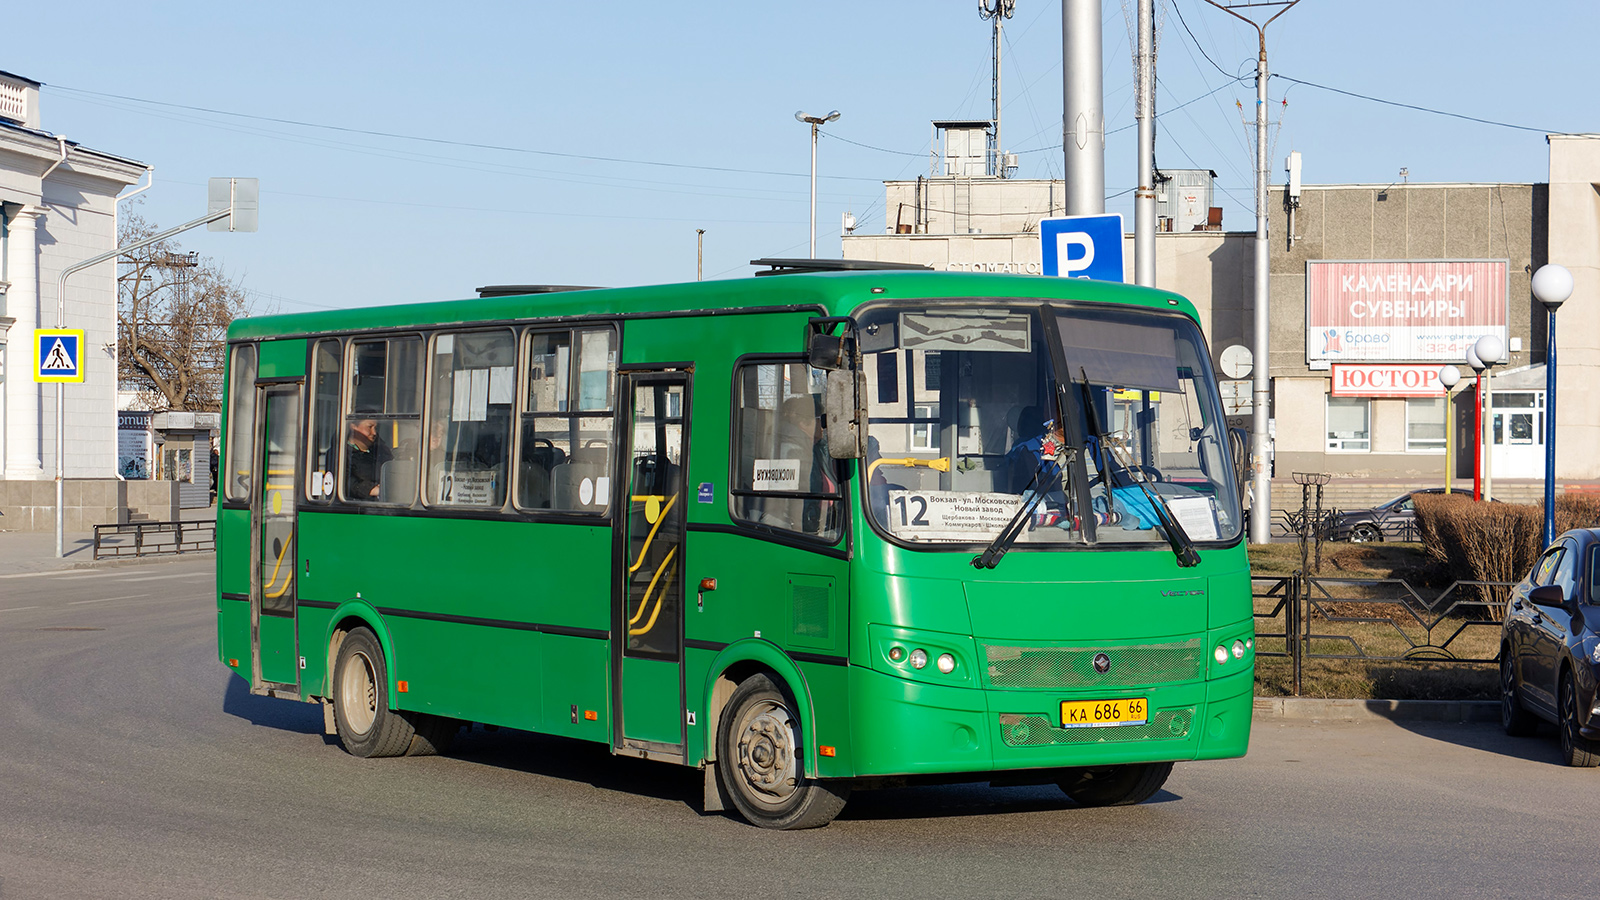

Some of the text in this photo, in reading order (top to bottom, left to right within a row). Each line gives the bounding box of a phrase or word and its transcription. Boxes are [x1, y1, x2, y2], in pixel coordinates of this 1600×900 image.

[1056, 231, 1095, 277] P
[946, 262, 1039, 274] СТОМАТО
[1342, 274, 1473, 295] КАЛЕНДАРИ
[1350, 300, 1465, 318] СУВЕНИРЫ
[1345, 331, 1390, 346] браво
[1341, 369, 1439, 388] ЮСТОР
[441, 475, 453, 501] 12
[894, 495, 929, 526] 12
[975, 497, 1019, 506] Московская
[1094, 703, 1121, 720] 686
[1128, 701, 1142, 714] 66
